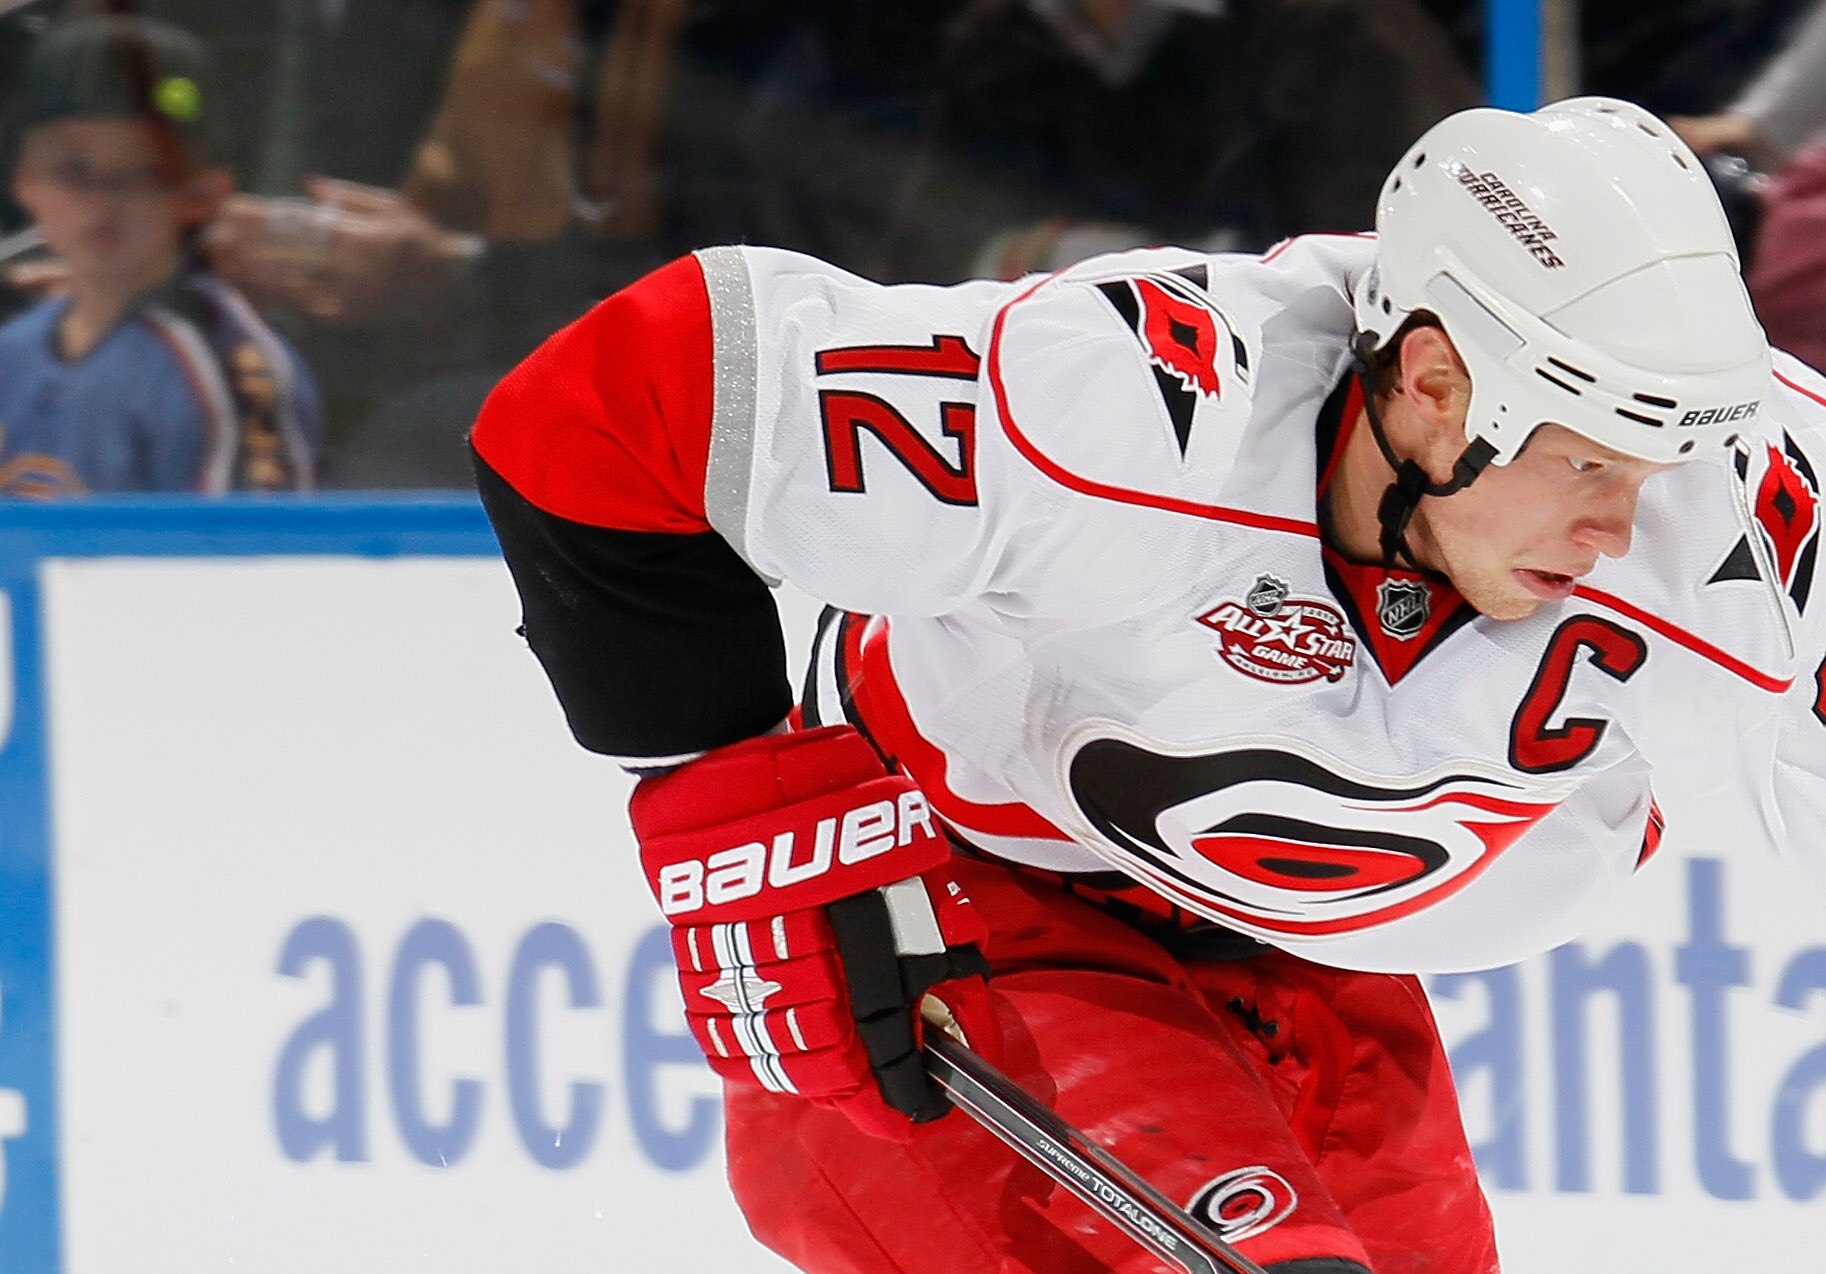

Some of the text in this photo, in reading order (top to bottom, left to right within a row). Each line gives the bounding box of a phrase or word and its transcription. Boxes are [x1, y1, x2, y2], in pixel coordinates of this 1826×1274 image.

[1456, 162, 1566, 270] URRICANES
[1480, 172, 1558, 240] CAROLINA
[816, 334, 981, 506] 12
[1207, 604, 1353, 661] ALL STAR
[1251, 645, 1308, 670] GAME
[1509, 614, 1648, 774] C
